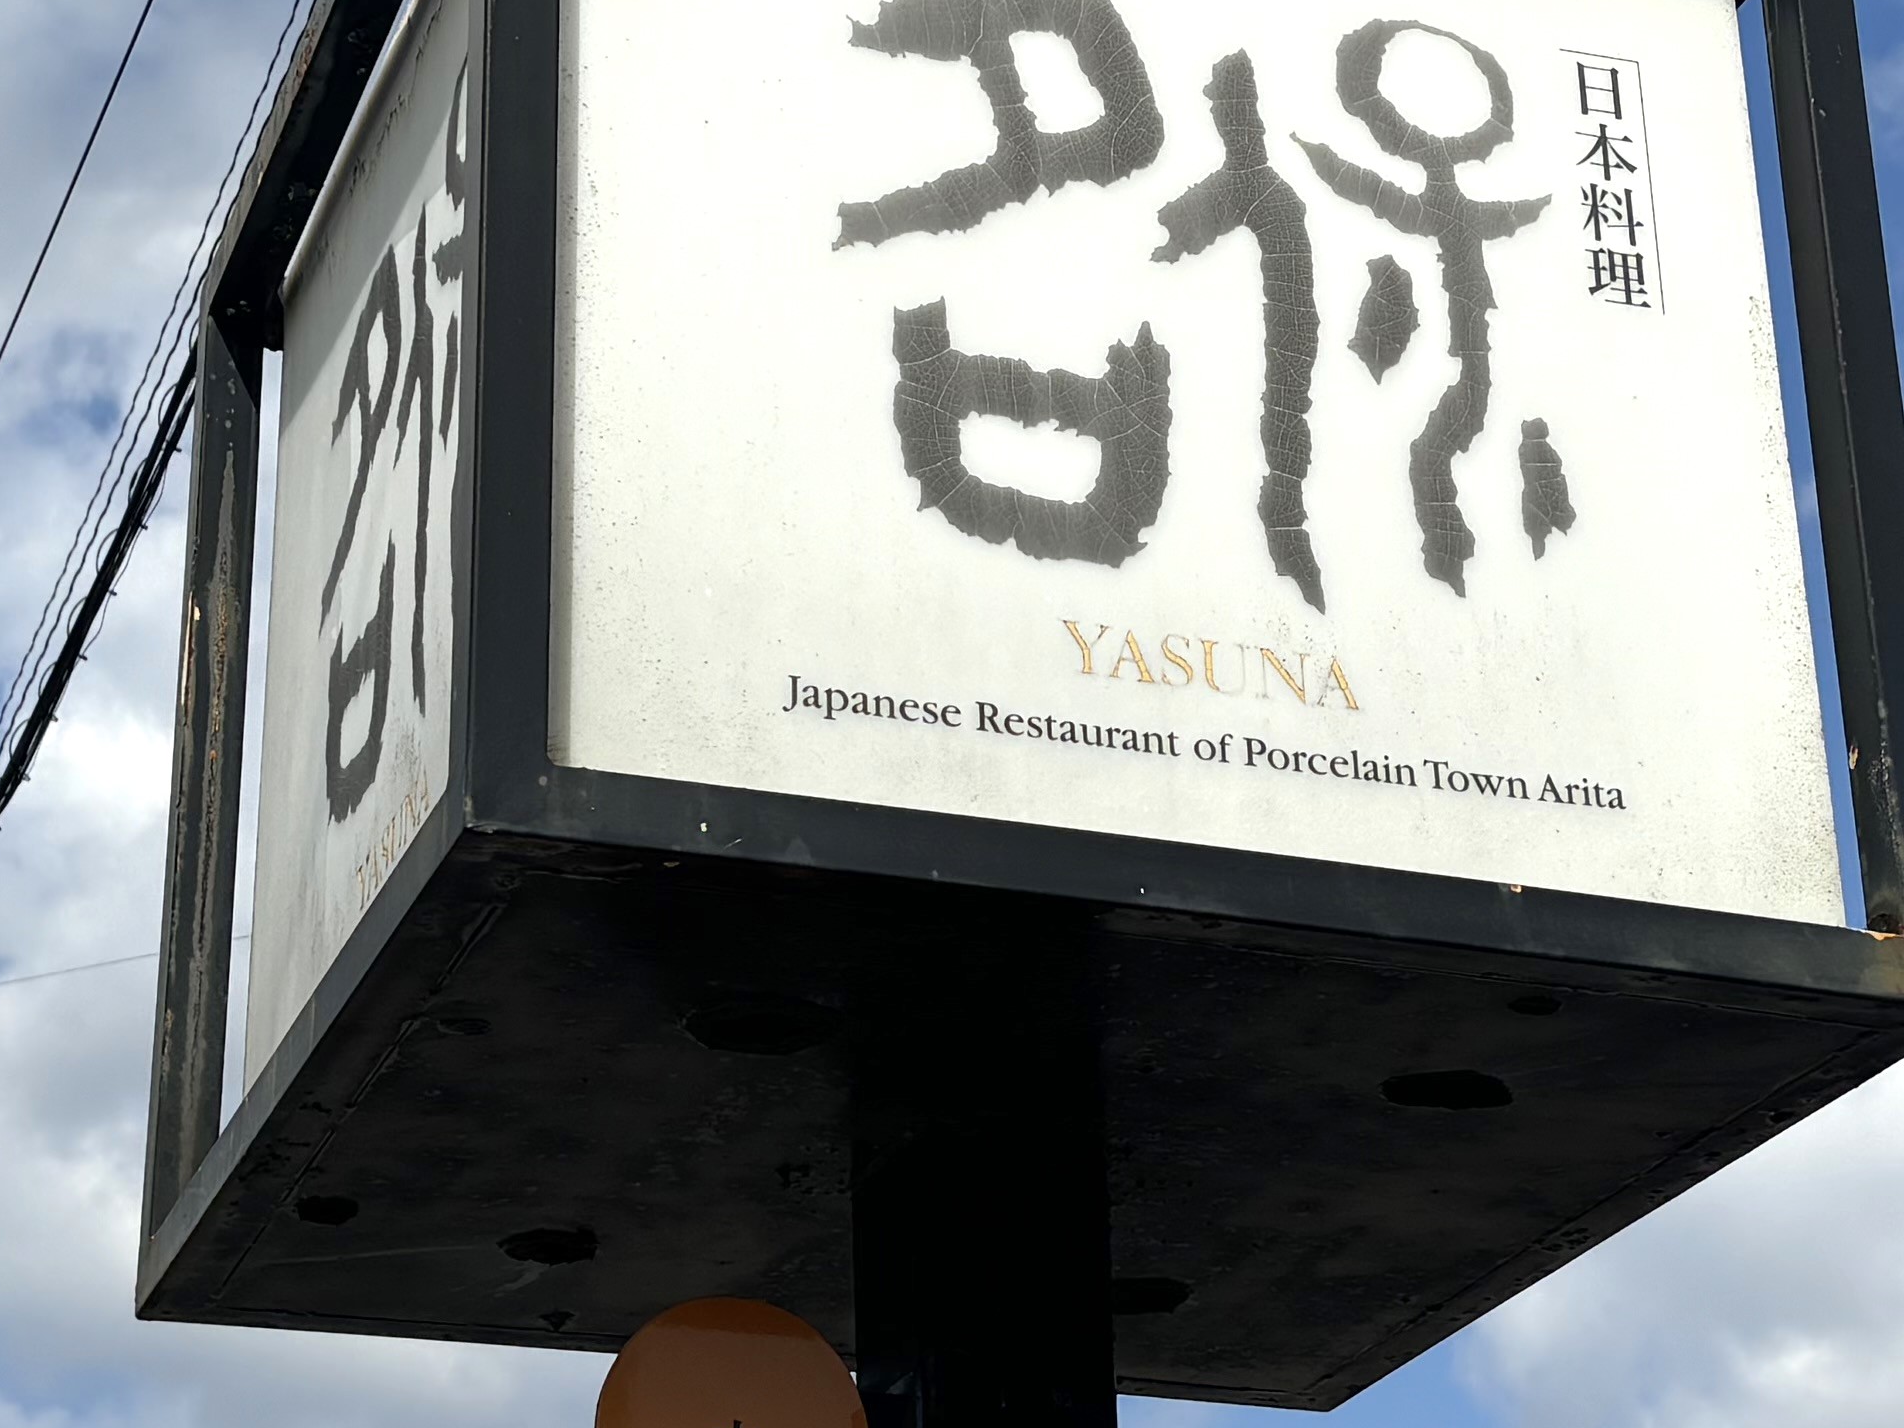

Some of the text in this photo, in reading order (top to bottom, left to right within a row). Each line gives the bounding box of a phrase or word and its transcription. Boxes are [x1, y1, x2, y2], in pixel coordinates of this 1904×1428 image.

[1574, 61, 1651, 308] 日本料理
[1058, 618, 1360, 711] YASUNA
[782, 674, 1627, 810] Japanese Restaurant of Porcelain Town Arita
